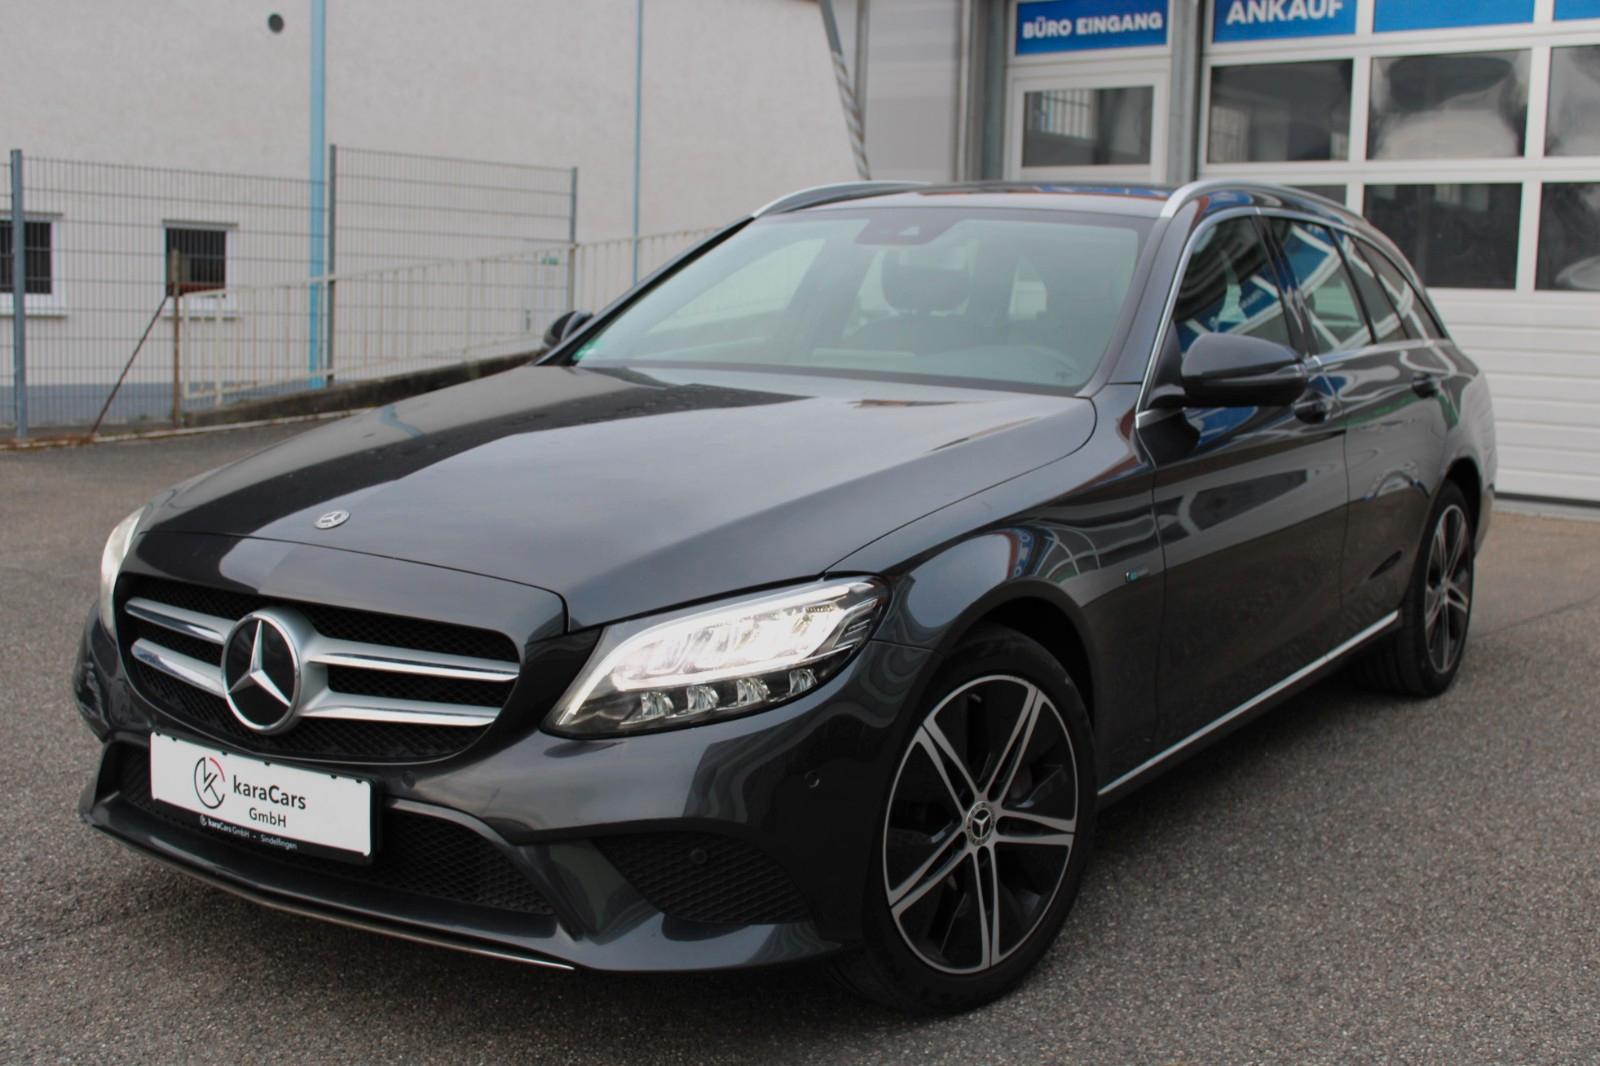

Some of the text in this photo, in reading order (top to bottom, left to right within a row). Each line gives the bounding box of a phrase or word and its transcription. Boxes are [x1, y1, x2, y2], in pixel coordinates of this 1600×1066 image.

[1022, 11, 1163, 39] BÜRO EINGANG
[1226, 0, 1343, 25] ANKAUF
[233, 774, 306, 810] karaCars
[249, 807, 286, 828] GmbH
